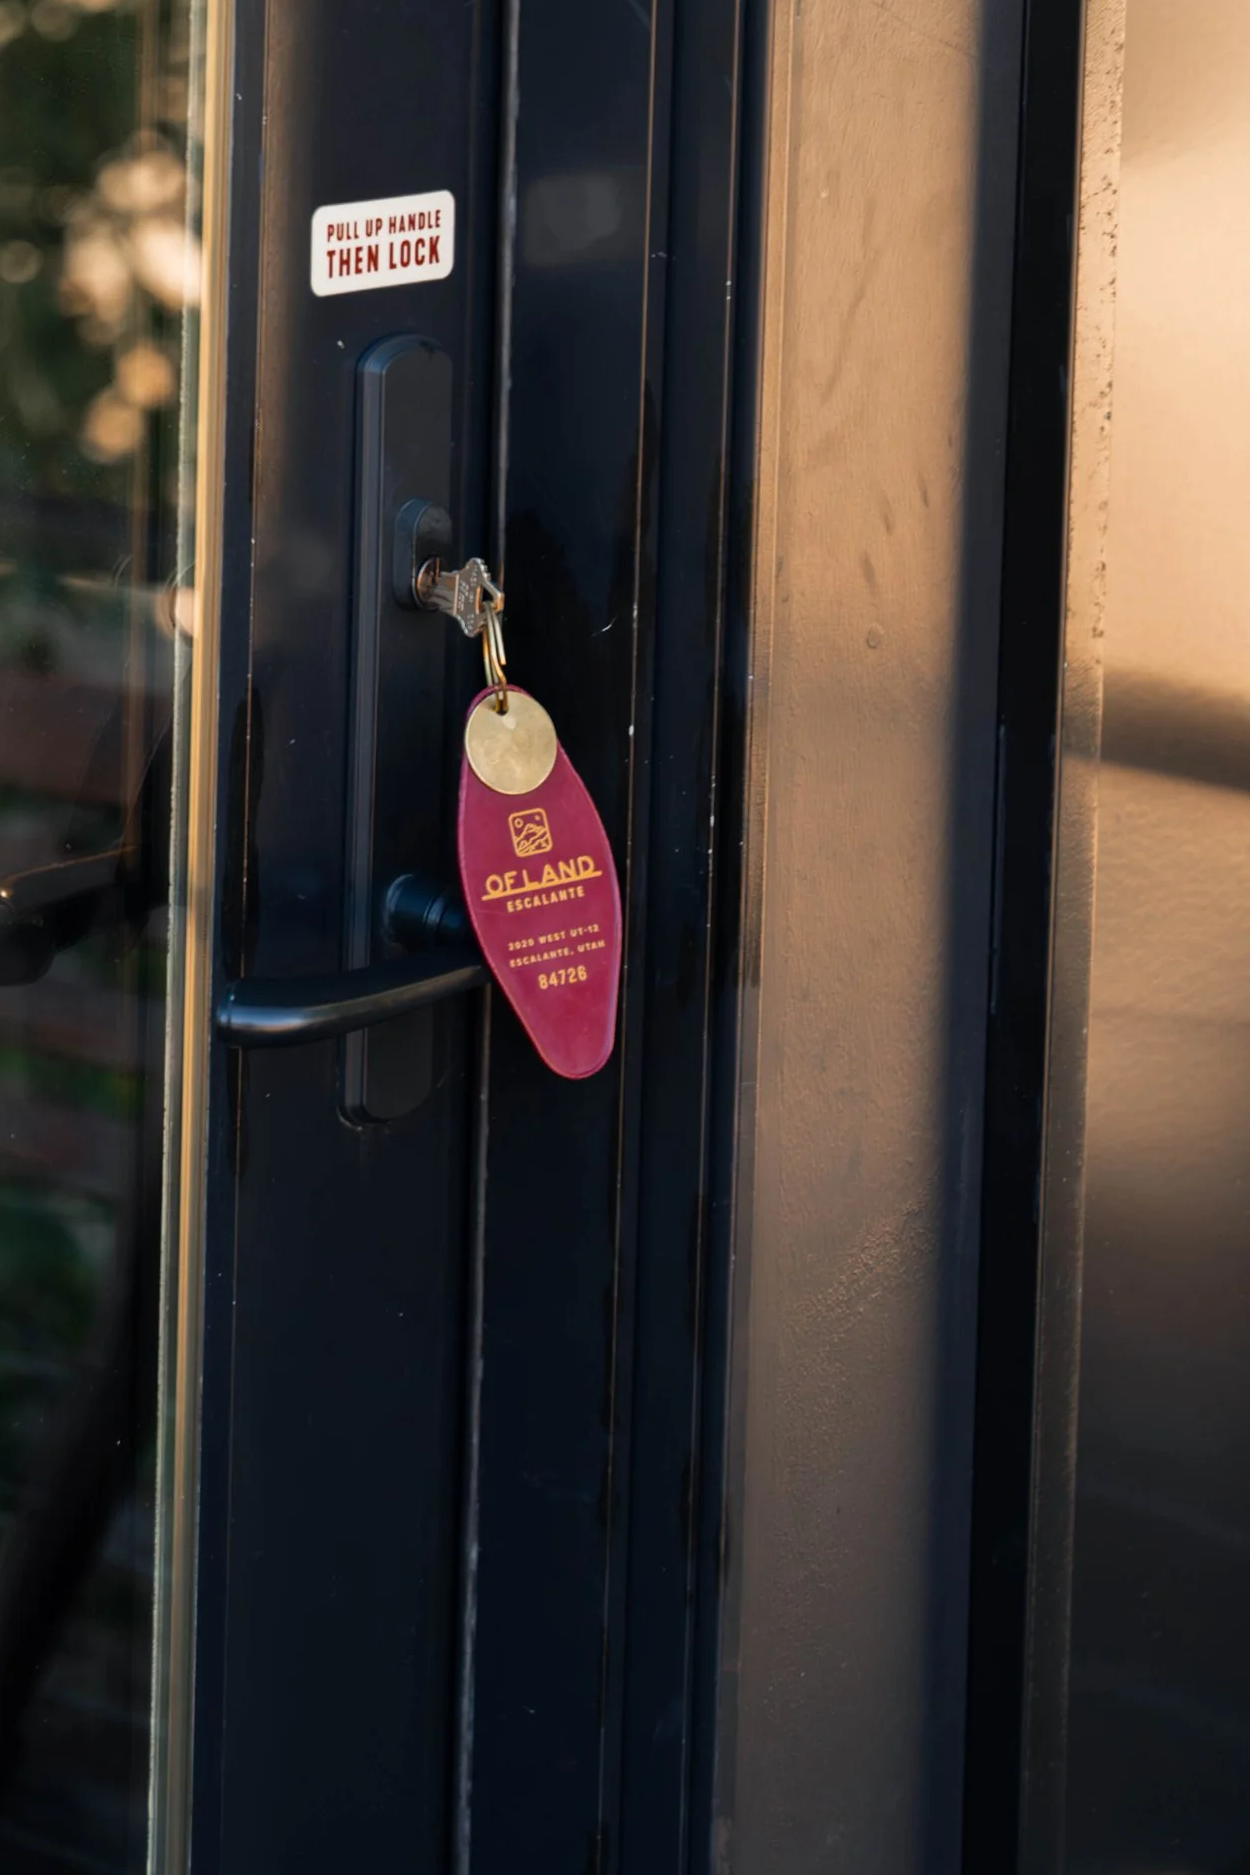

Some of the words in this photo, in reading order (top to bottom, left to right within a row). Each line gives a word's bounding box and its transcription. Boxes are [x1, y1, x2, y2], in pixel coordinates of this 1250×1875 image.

[327, 223, 360, 242] PULL
[366, 218, 383, 238] UP
[389, 209, 441, 234] HANDLE
[327, 244, 379, 278] THEN
[389, 235, 440, 270] LOCK
[506, 886, 585, 913] ESCALANTE
[508, 938, 535, 951] 2020
[538, 931, 566, 945] WEST
[570, 924, 600, 938] UT-12
[509, 947, 575, 968] ESCALANTE,
[577, 939, 606, 953] UTAH
[538, 965, 588, 990] 84726
